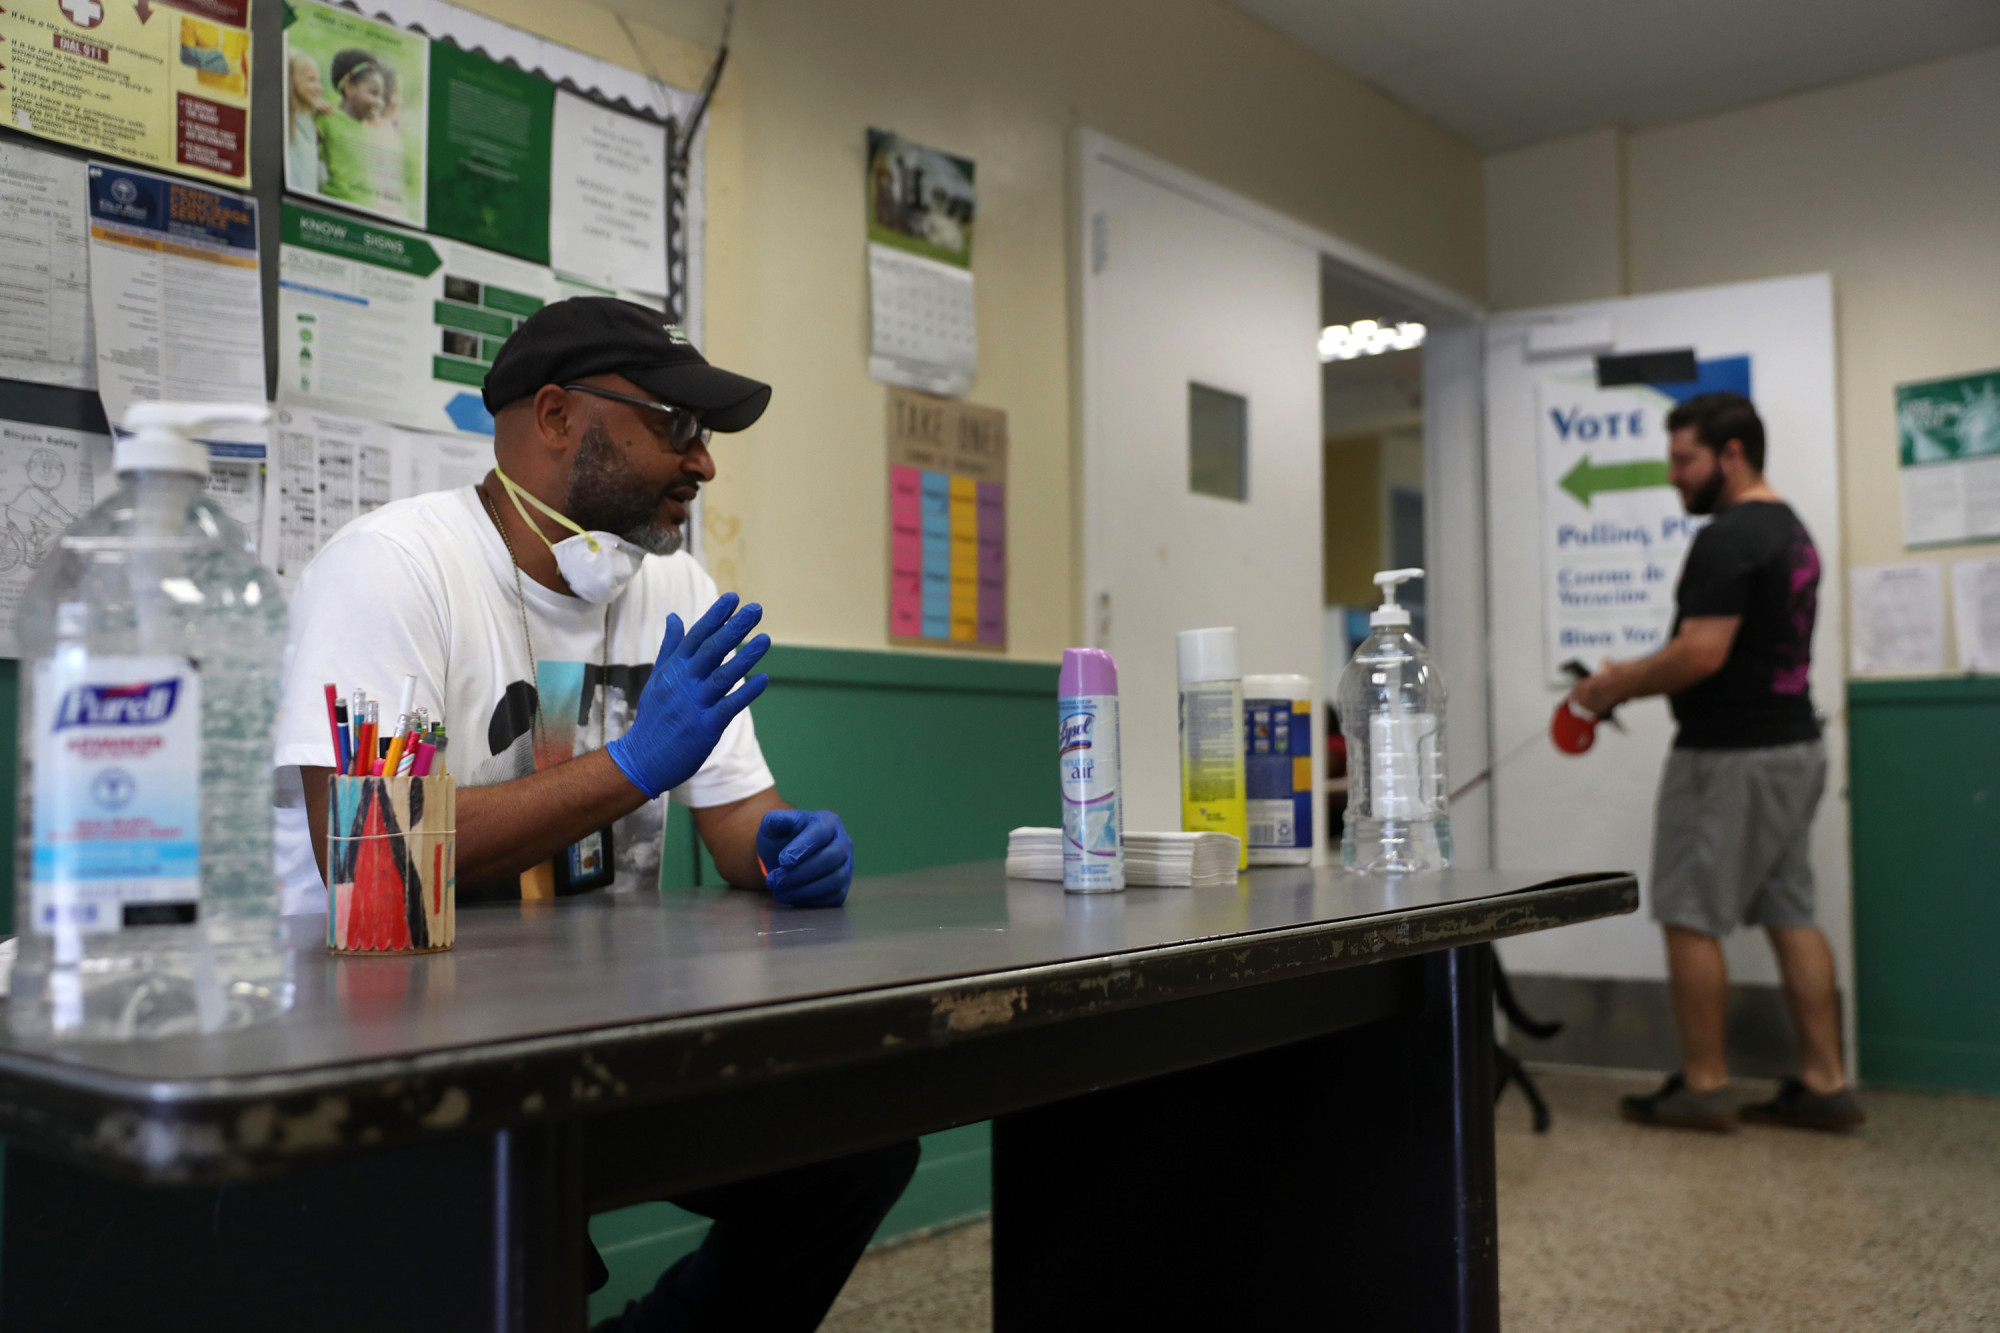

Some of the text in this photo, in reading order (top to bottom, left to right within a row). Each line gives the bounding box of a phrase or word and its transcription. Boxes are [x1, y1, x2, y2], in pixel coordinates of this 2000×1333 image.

[60, 37, 102, 61] DIAL 911
[170, 183, 219, 202] PERMIT
[170, 195, 249, 225] CONCIERGE
[170, 207, 228, 230] SERVICE
[300, 216, 347, 240] KNOW
[363, 232, 405, 255] SIGNS
[1551, 407, 1646, 441] VOTE
[3, 428, 79, 449] Bicycle Safety
[1558, 522, 1652, 548] Polling
[1071, 765, 1095, 779] air
